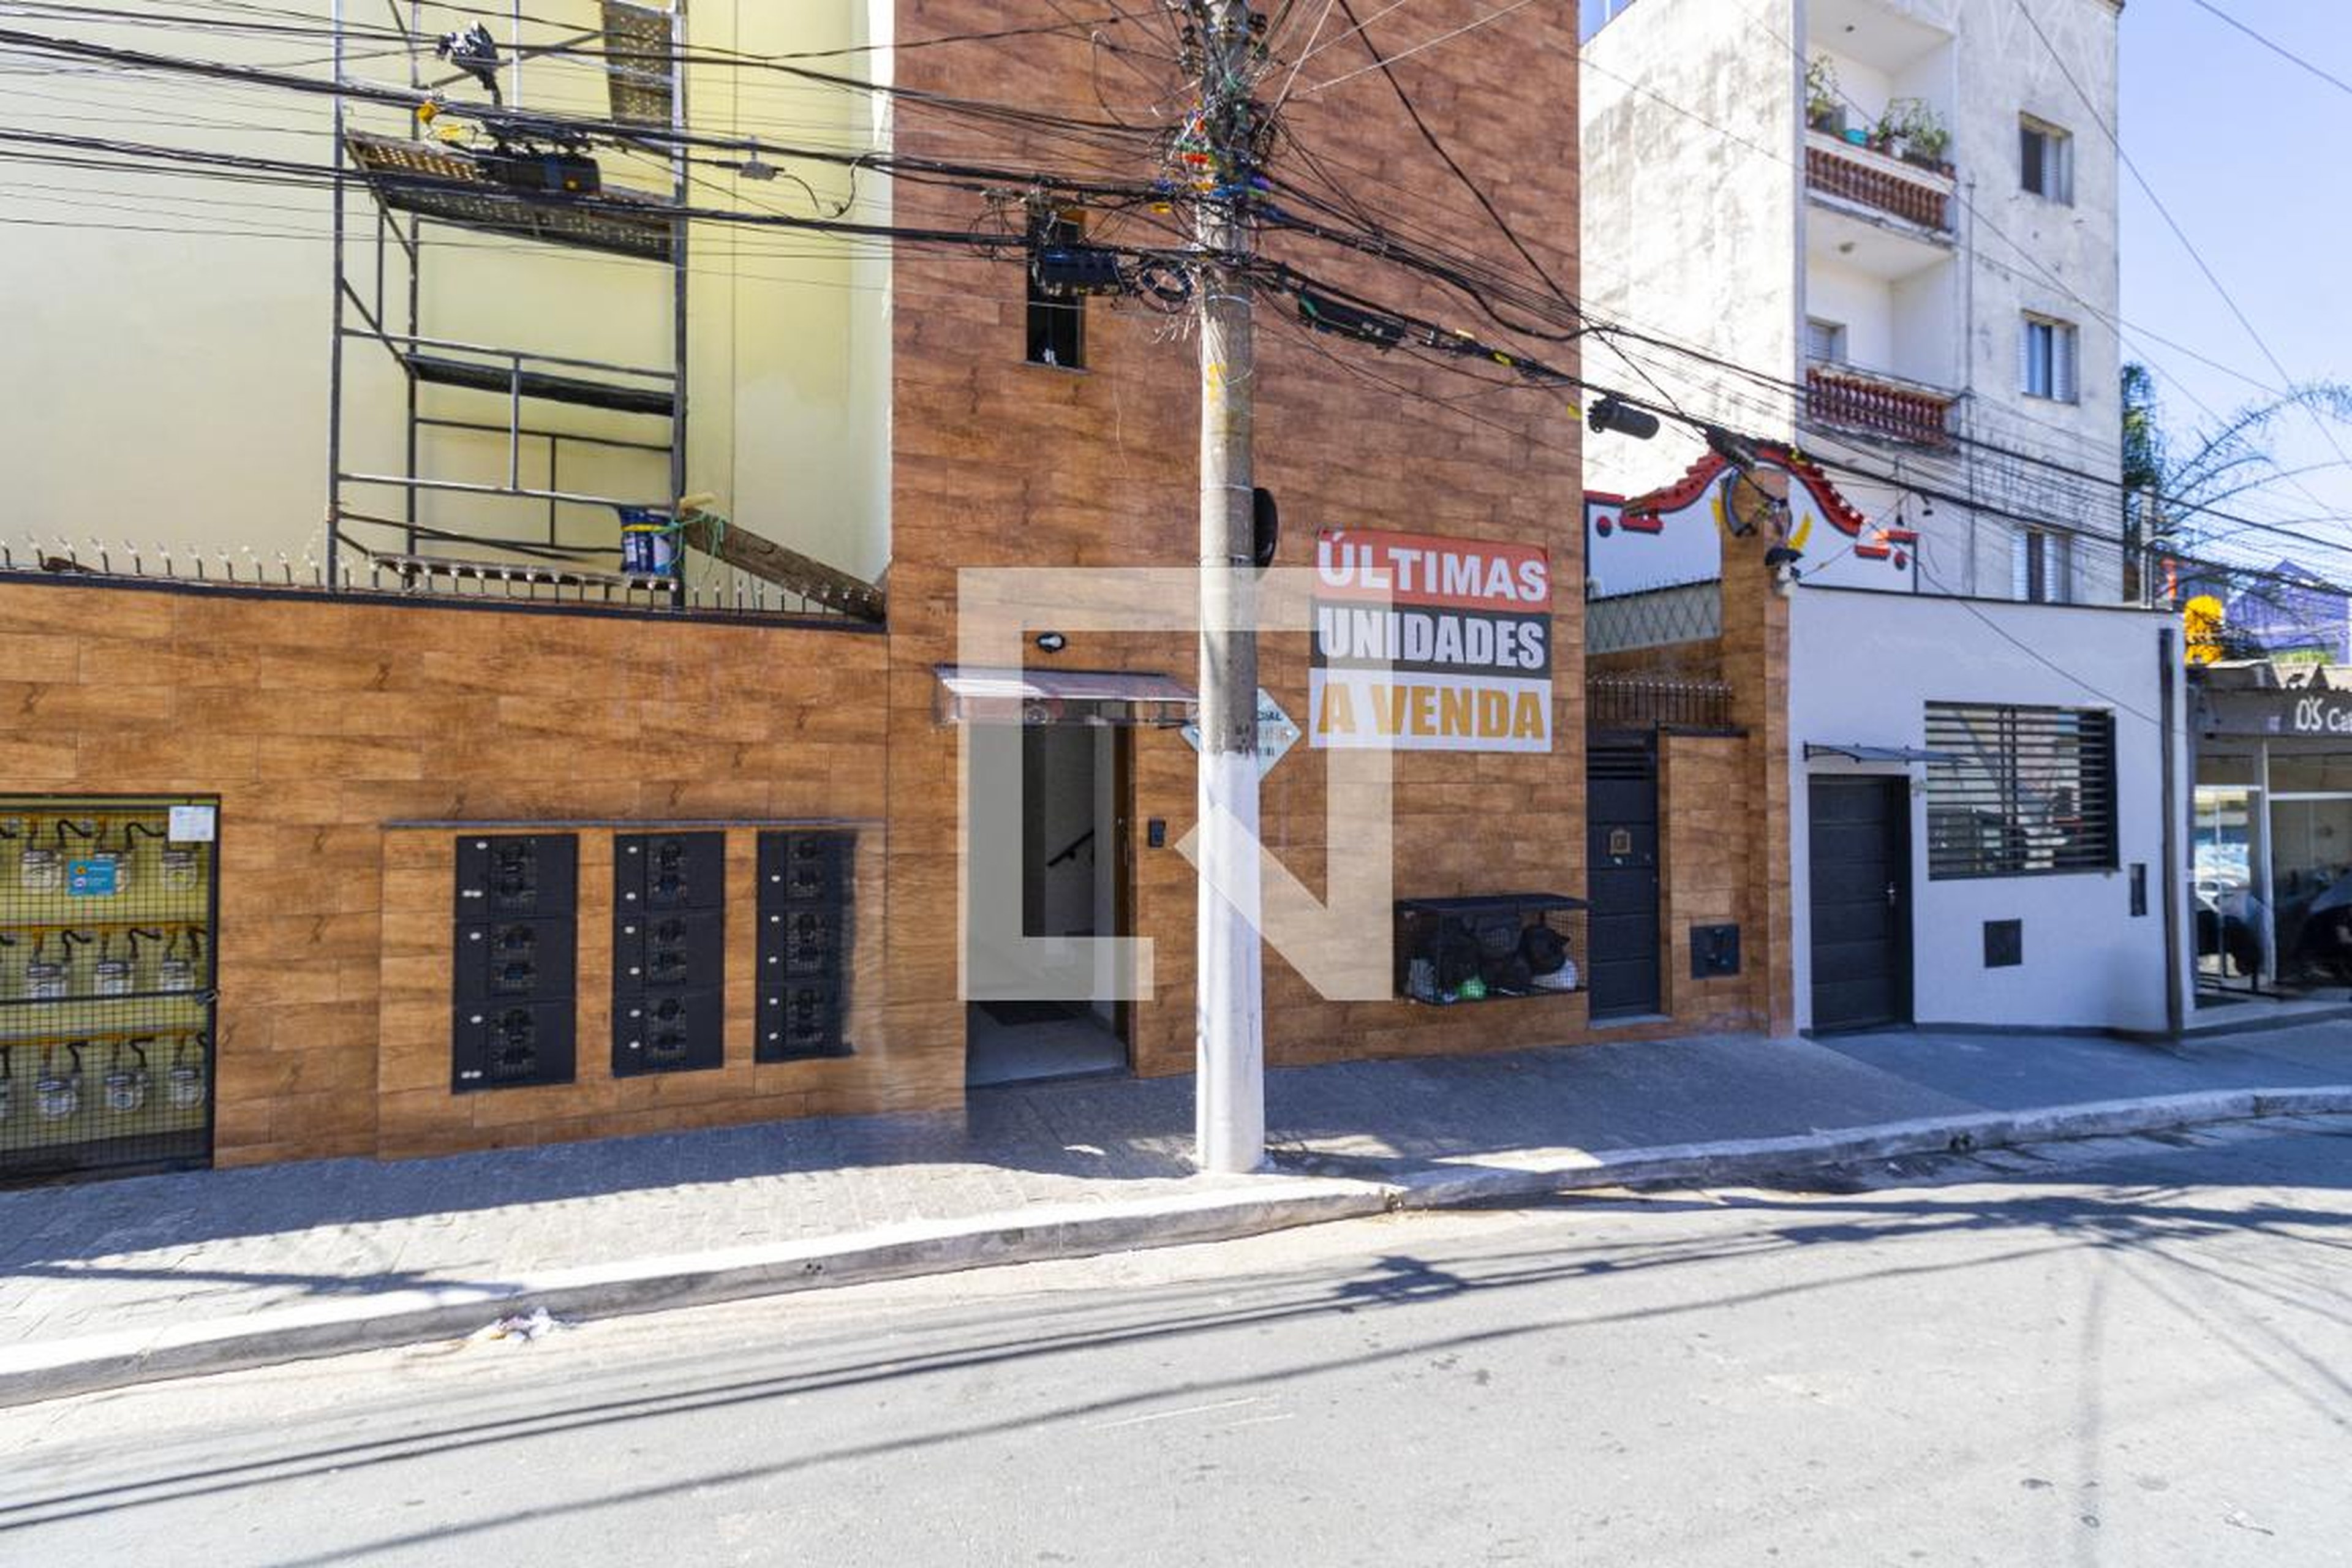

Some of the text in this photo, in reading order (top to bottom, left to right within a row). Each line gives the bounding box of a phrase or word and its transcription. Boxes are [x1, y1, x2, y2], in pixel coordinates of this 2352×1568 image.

[1318, 532, 1547, 602] ÚLTIMAS
[1318, 606, 1545, 670] UNIDADES
[1317, 683, 1546, 740] A VENDA
